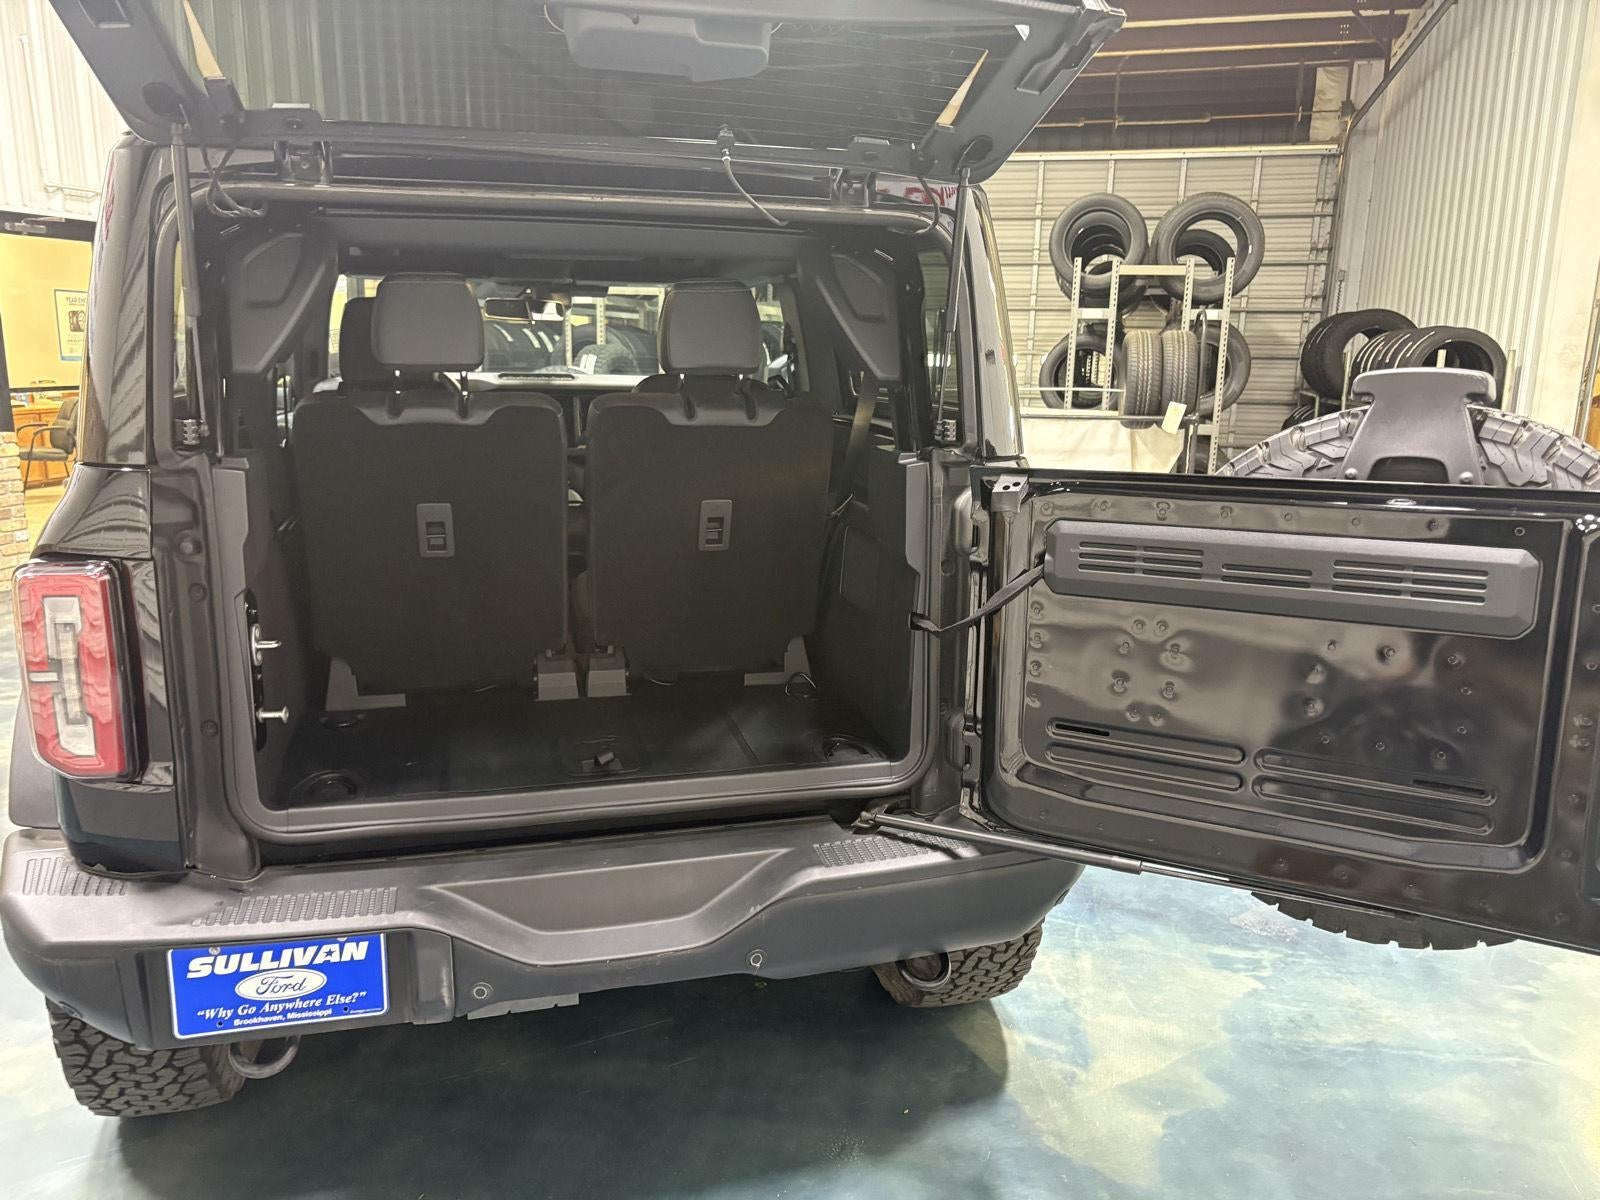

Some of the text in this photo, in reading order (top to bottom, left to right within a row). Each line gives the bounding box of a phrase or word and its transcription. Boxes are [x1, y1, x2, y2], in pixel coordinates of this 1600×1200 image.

[187, 941, 369, 978] SULLIVAN
[256, 976, 307, 995] Ford
[237, 1004, 257, 1015] Go
[260, 998, 322, 1013] Anywhere
[233, 1008, 333, 1026] Brookhaven, Mississippi
